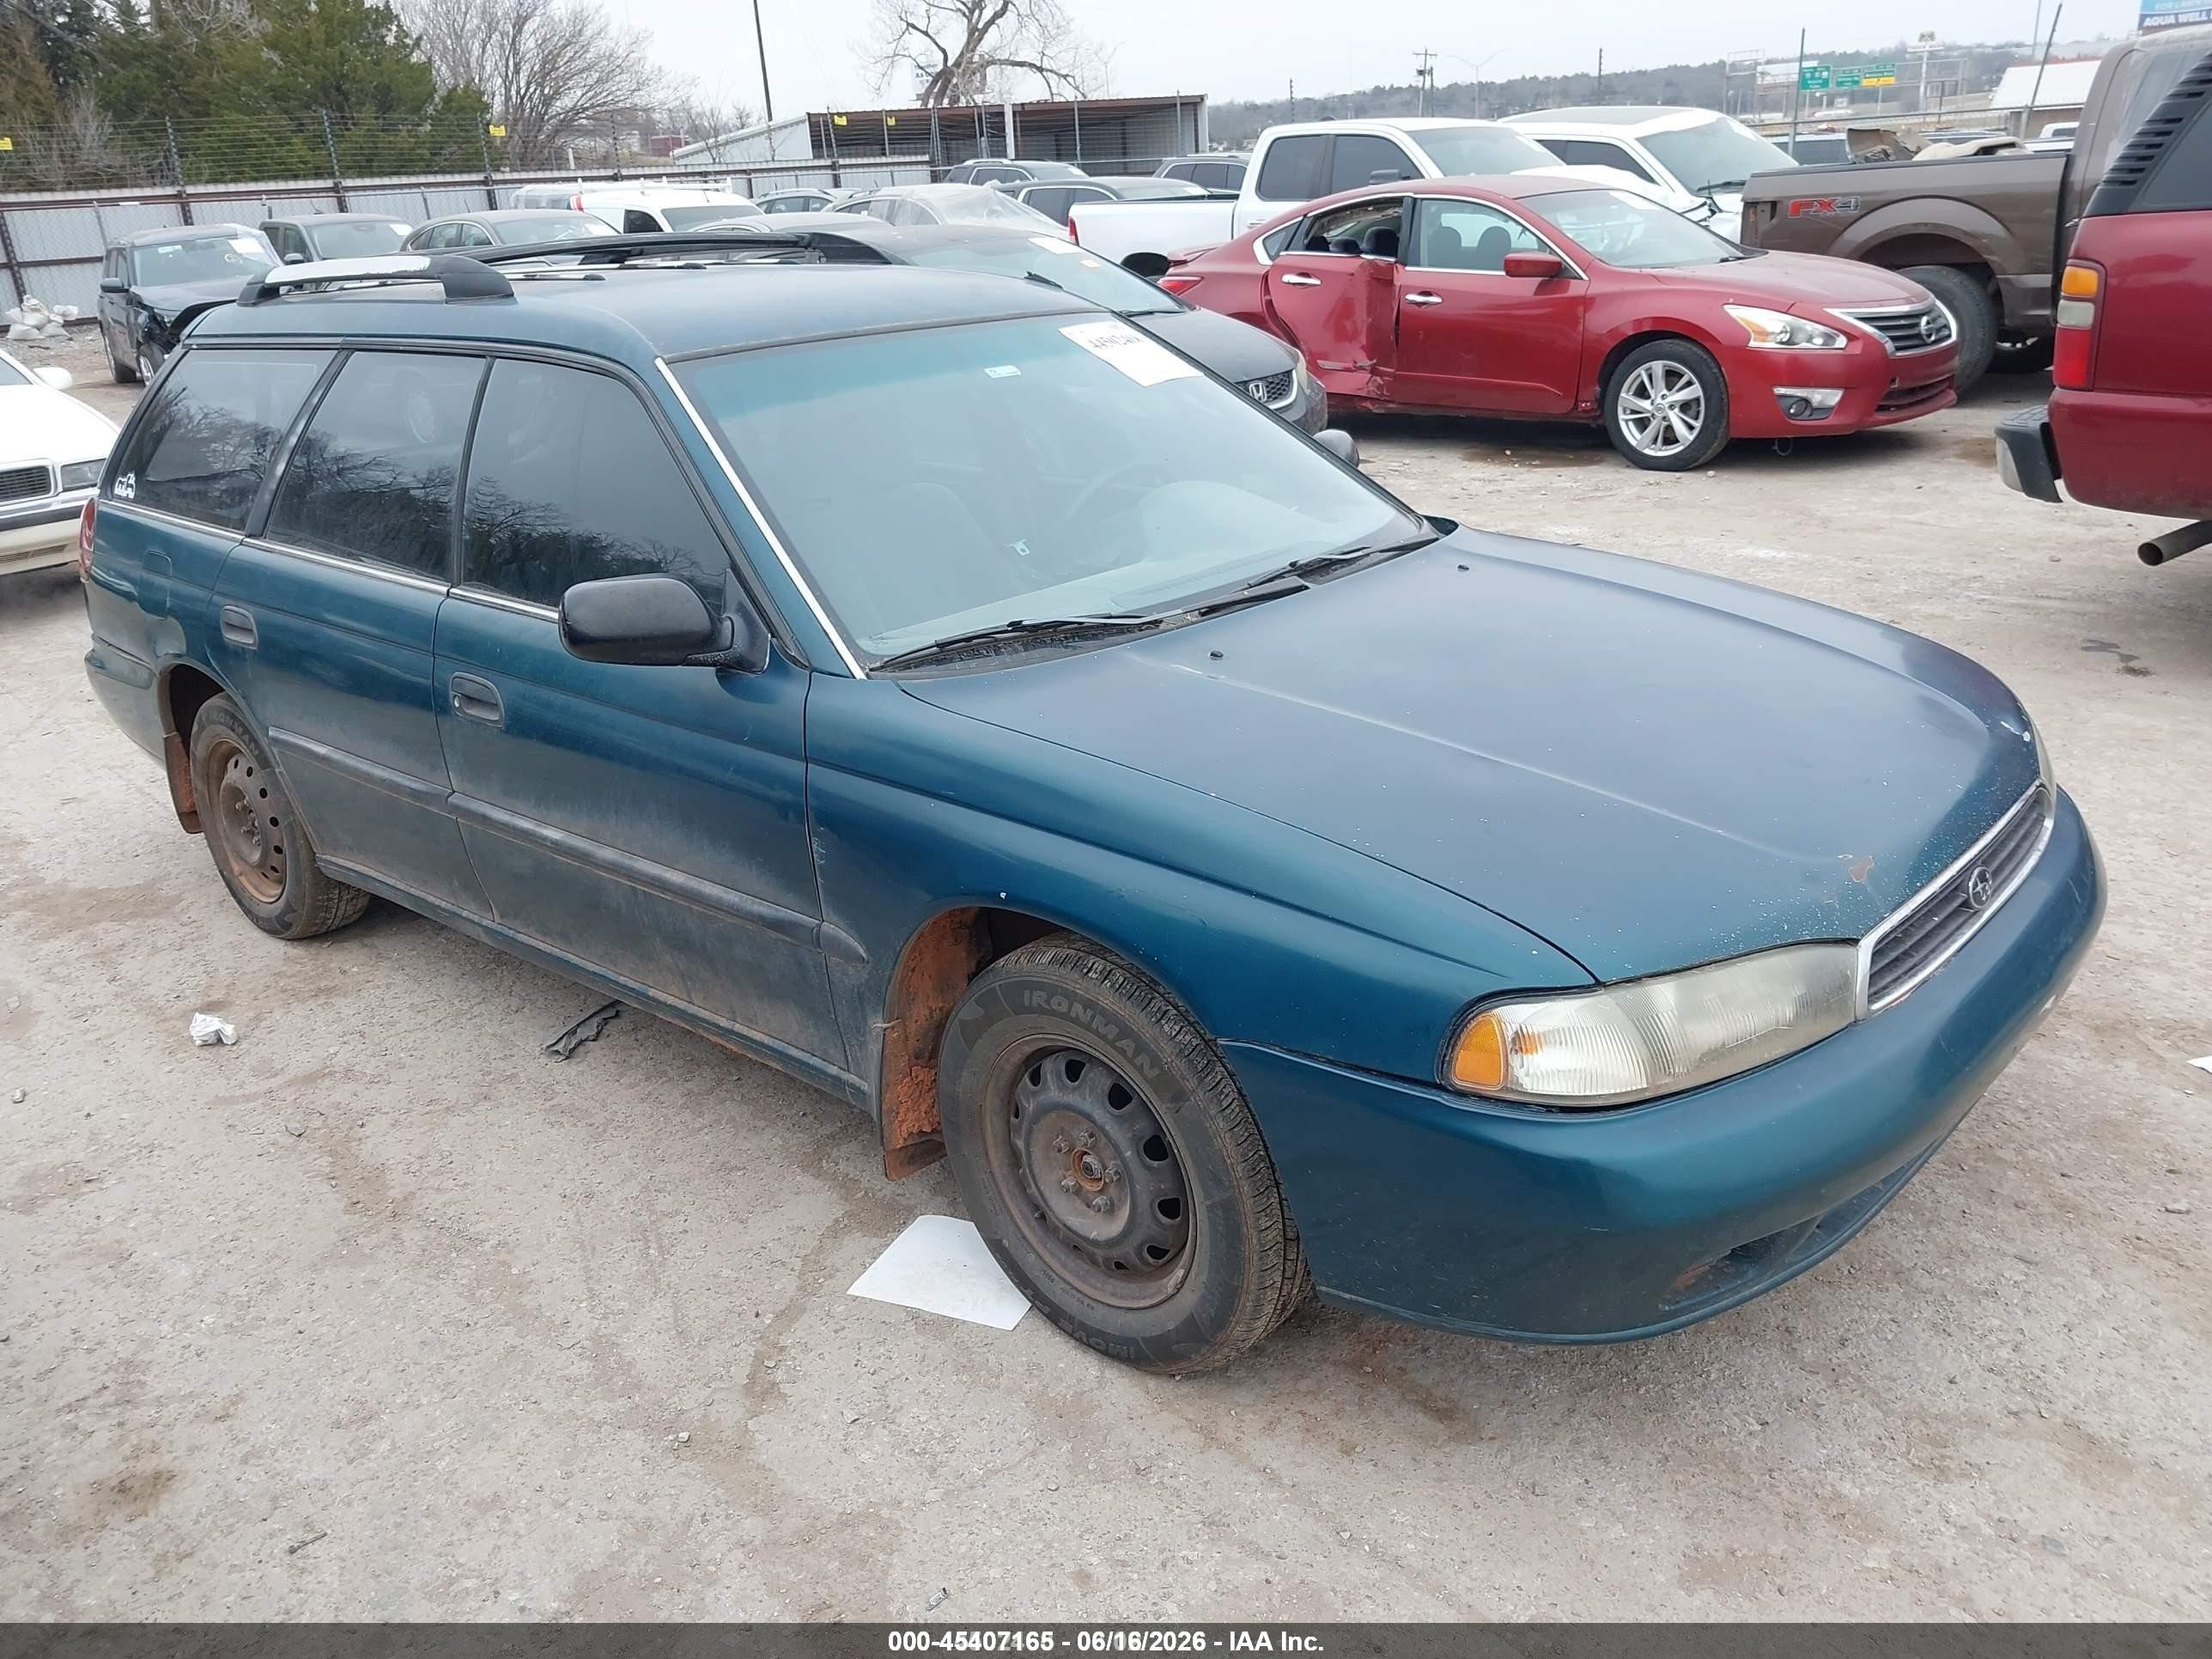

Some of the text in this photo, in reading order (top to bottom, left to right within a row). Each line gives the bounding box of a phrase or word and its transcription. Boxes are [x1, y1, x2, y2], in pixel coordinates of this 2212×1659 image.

[2142, 15, 2176, 27] AQUA
[2177, 10, 2209, 23] WELL
[1789, 196, 1860, 218] FX4
[1024, 988, 1161, 1079] IRONMAN
